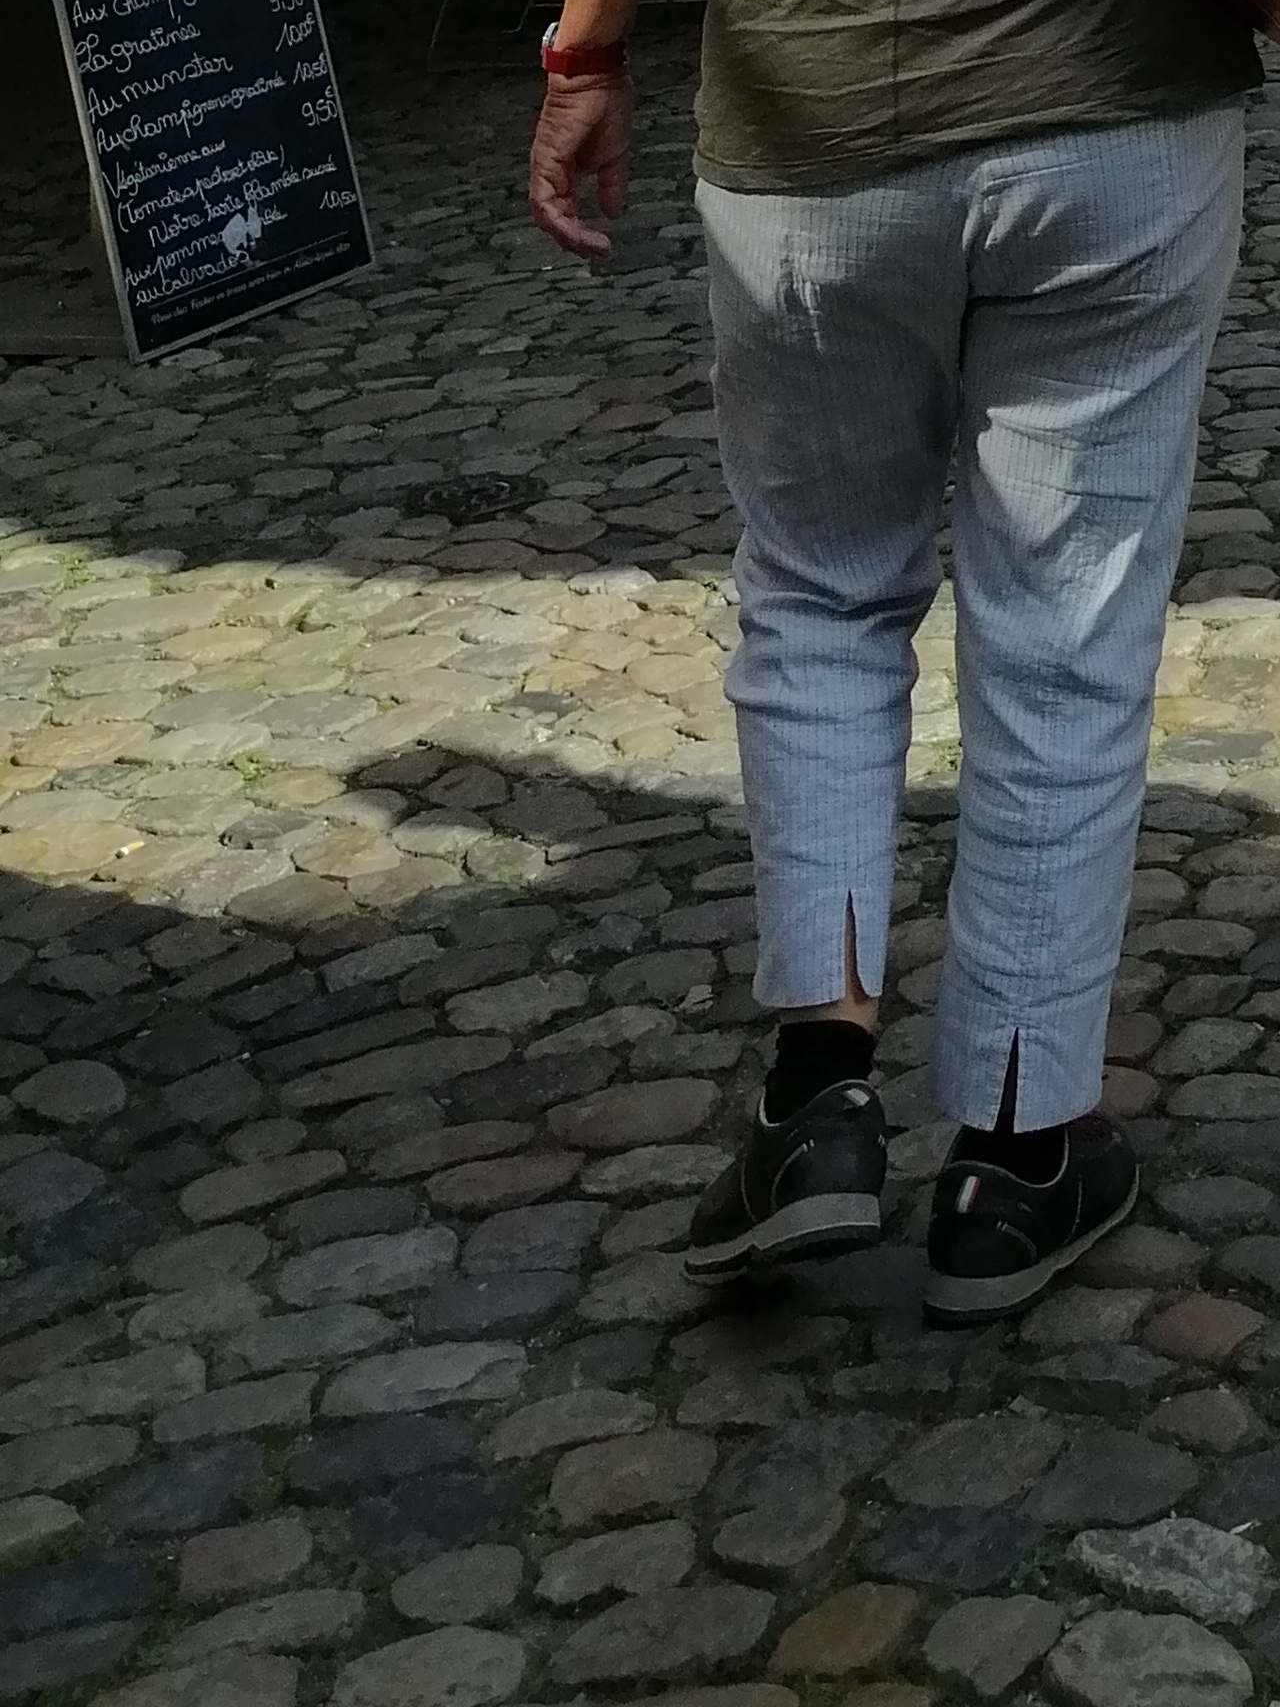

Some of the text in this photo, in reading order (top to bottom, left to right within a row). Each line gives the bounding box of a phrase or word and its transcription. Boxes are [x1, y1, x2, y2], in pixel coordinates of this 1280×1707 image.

[72, 0, 109, 27] Aux
[75, 33, 112, 74] La
[87, 87, 122, 124] Au
[124, 52, 234, 102] munster
[204, 193, 244, 222] tarte
